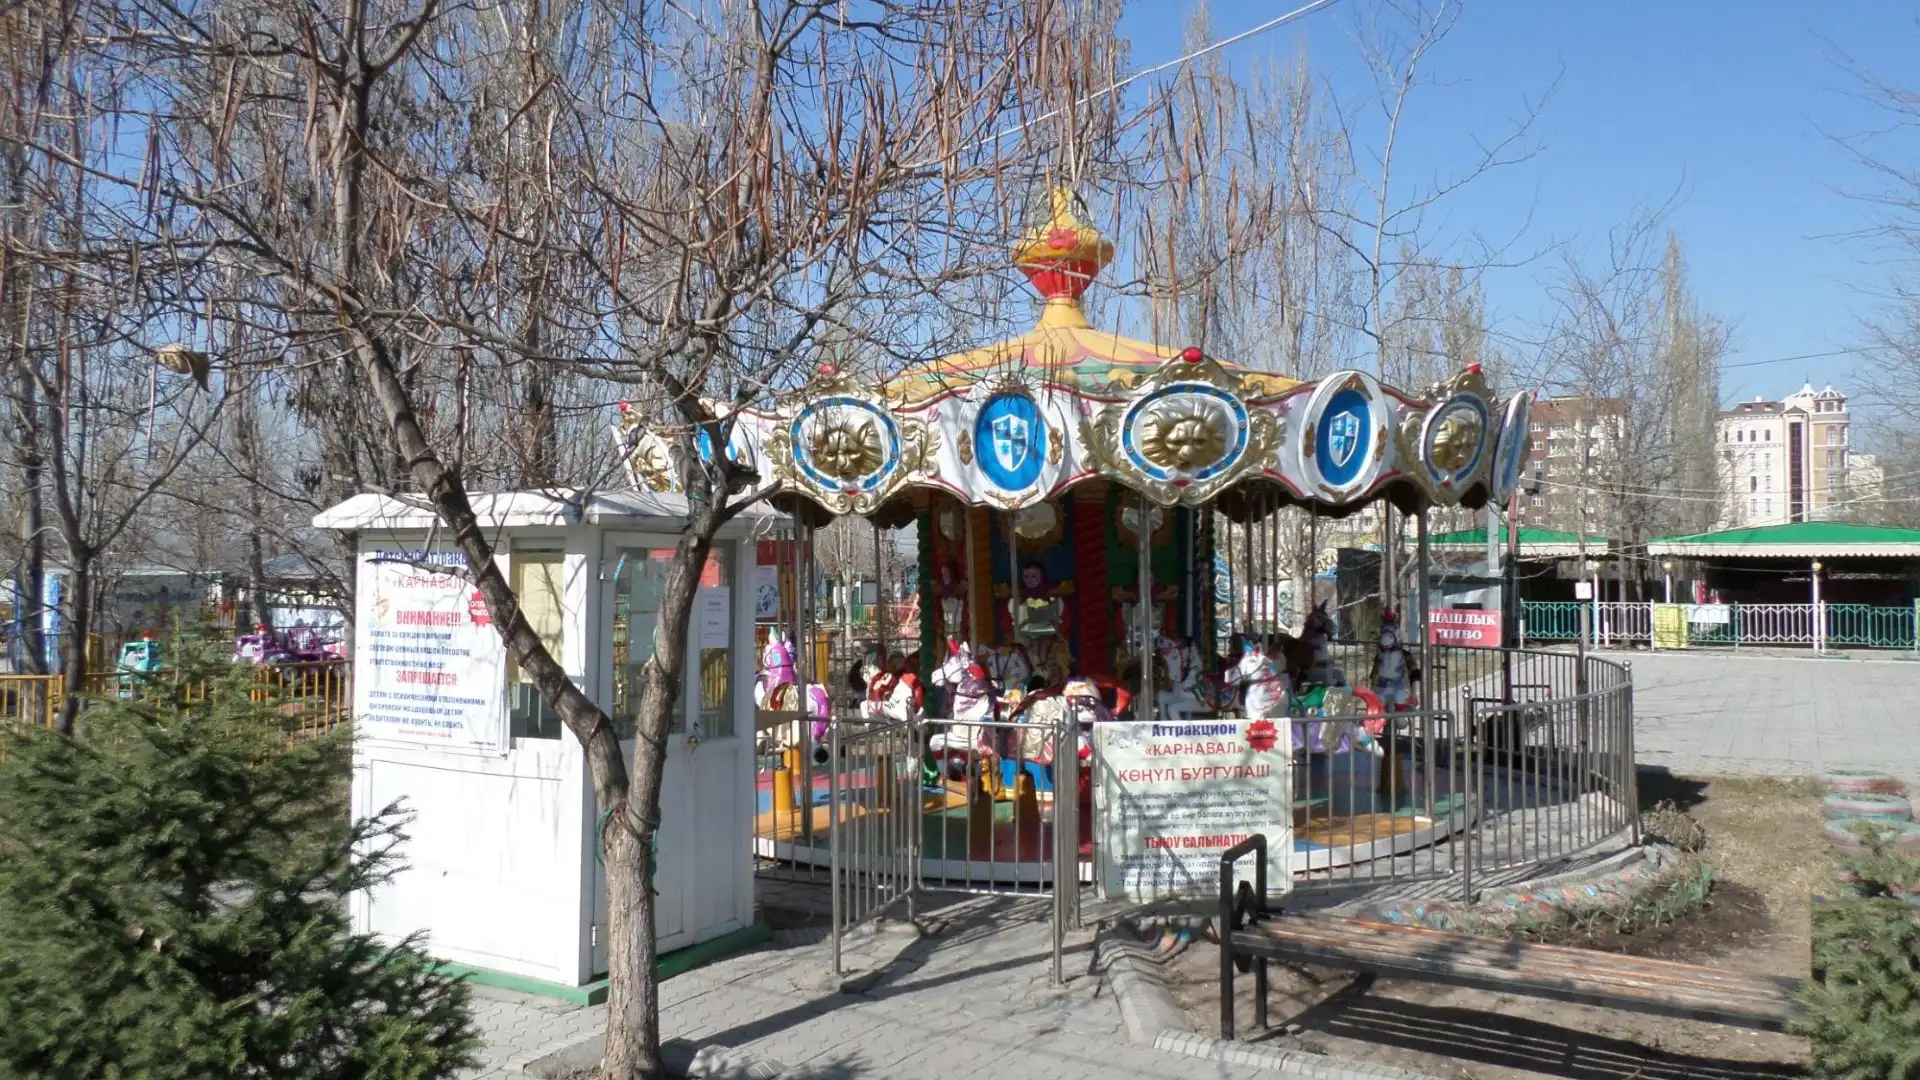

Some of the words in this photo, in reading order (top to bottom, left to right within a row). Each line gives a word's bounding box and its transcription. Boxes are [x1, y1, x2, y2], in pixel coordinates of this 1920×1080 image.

[396, 610, 461, 626] ВНИМАНИЕ!!!
[1152, 724, 1237, 737] Аттракцион
[1145, 741, 1244, 756] «КАРНАВАЛ»
[1119, 768, 1175, 783] КӨҢҮЛ
